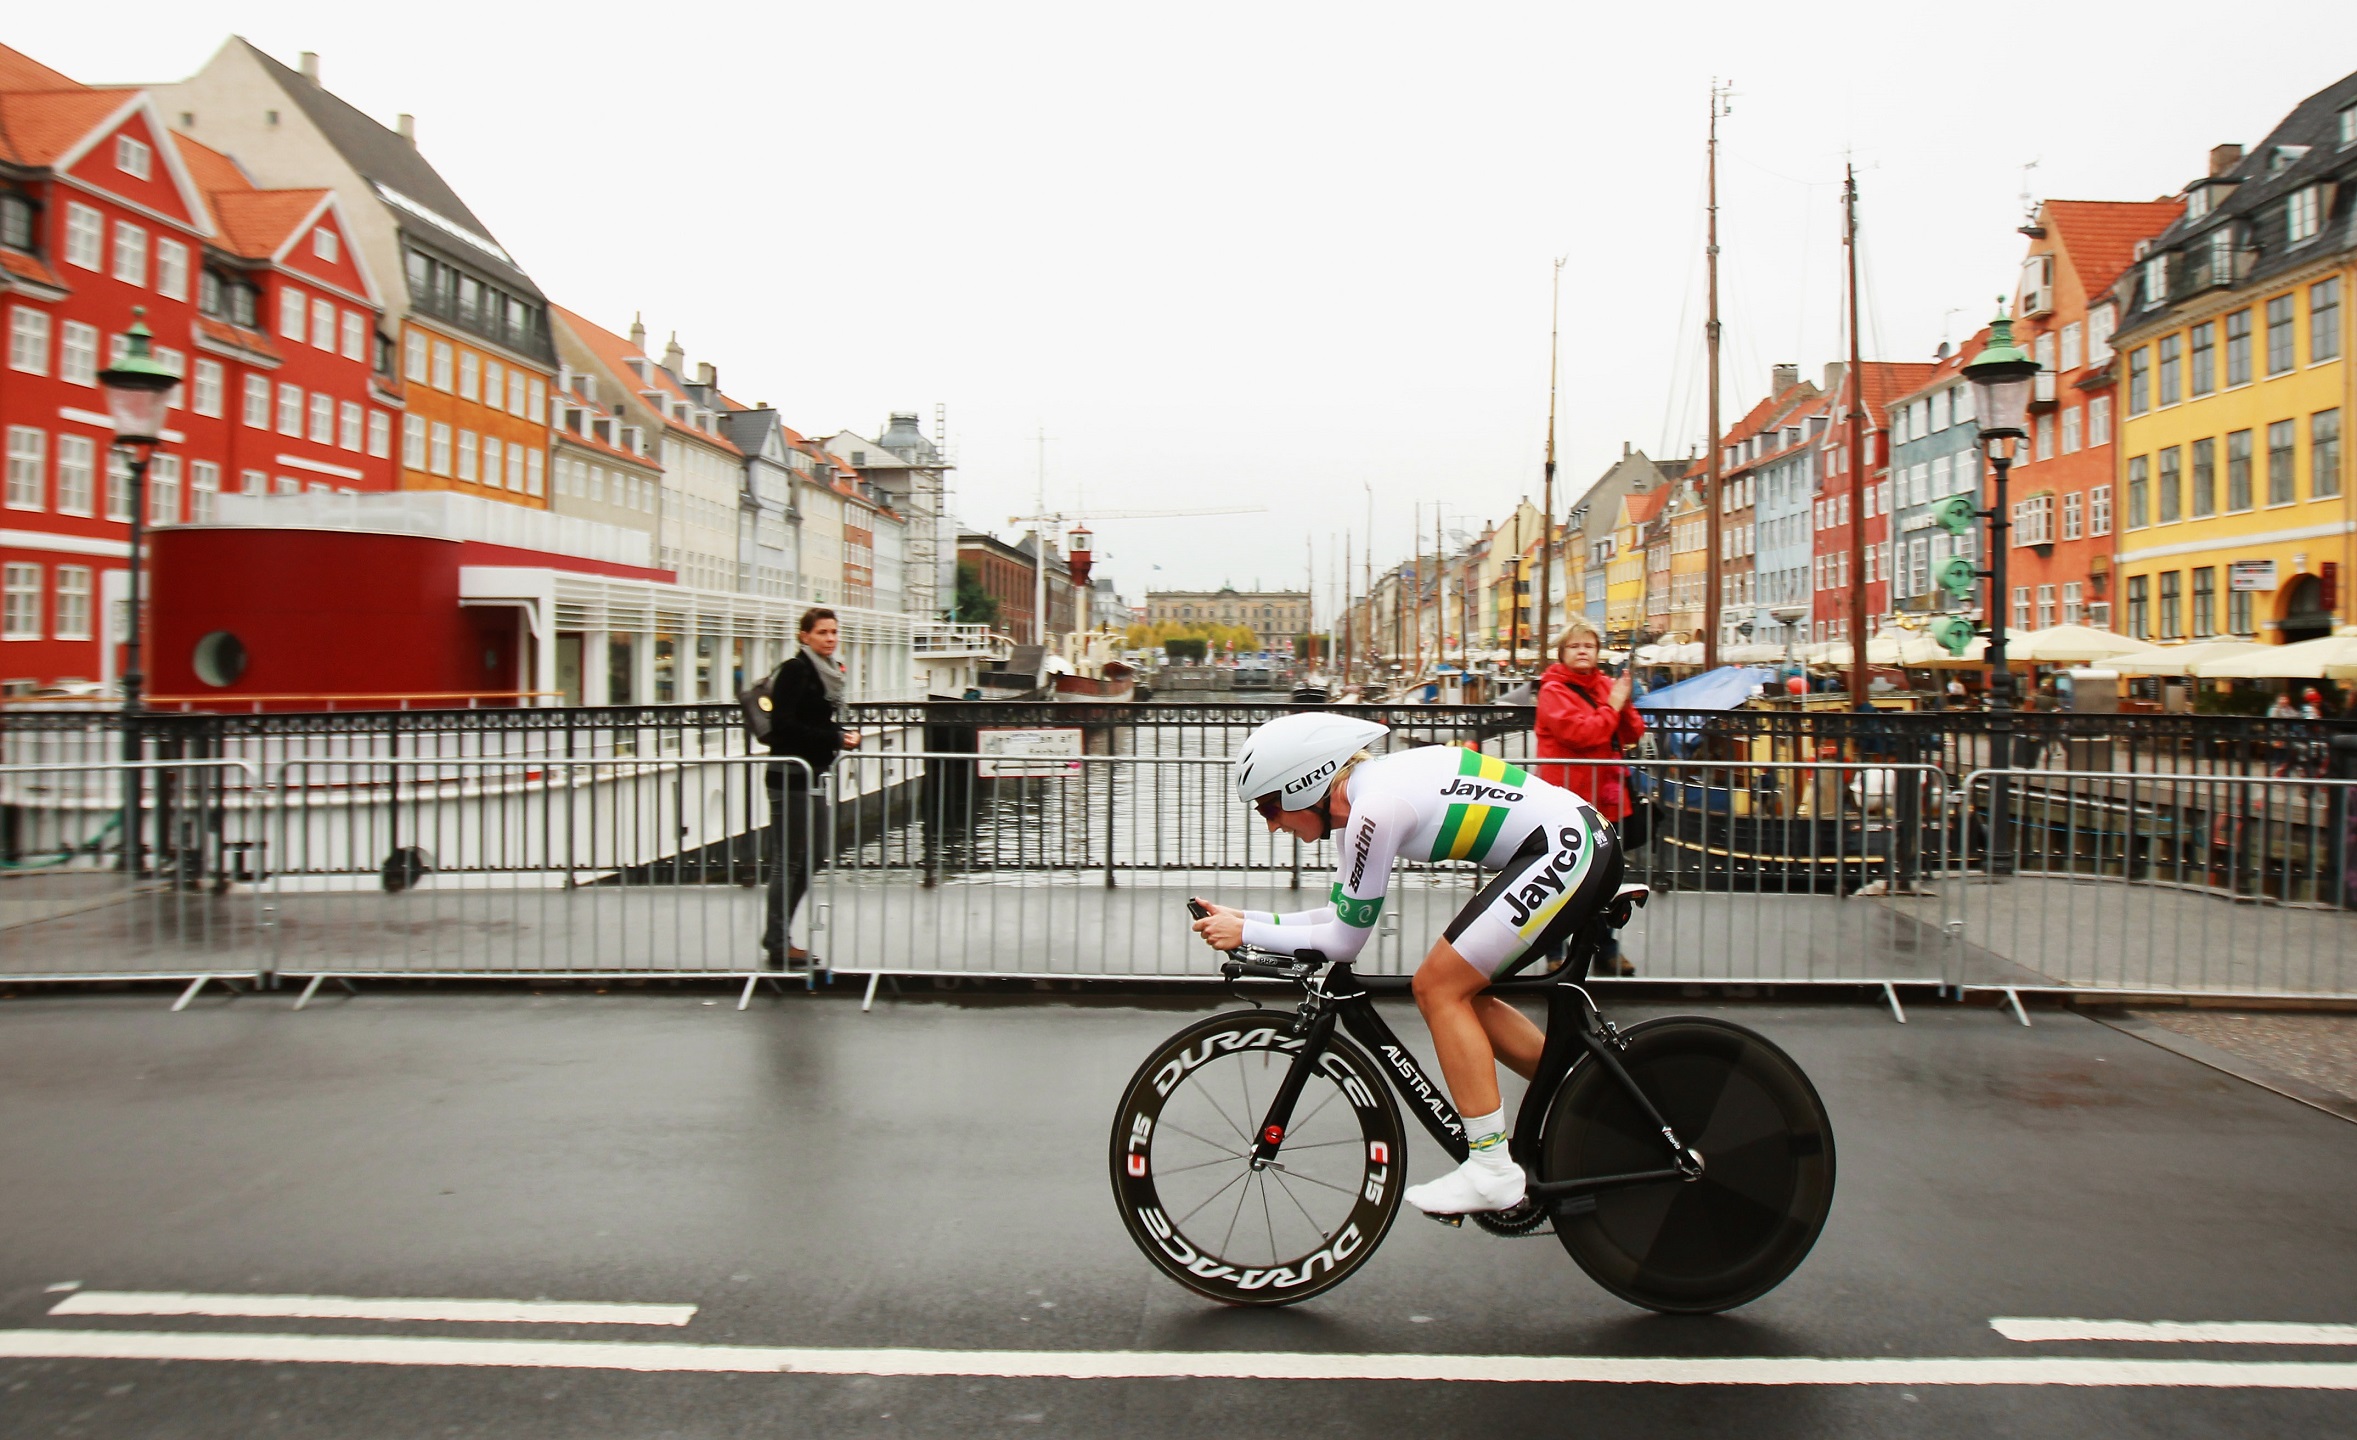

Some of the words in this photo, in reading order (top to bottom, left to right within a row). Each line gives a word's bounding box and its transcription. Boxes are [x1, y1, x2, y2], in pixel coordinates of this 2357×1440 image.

[1285, 760, 1337, 794] GIRO
[1440, 778, 1524, 802] Jayco
[1503, 827, 1582, 927] Jayco
[1380, 1045, 1462, 1136] AUSTRALIA
[1127, 1112, 1152, 1177] C75
[1364, 1140, 1389, 1206] C75
[1137, 1206, 1364, 1290] DURA-ACE
